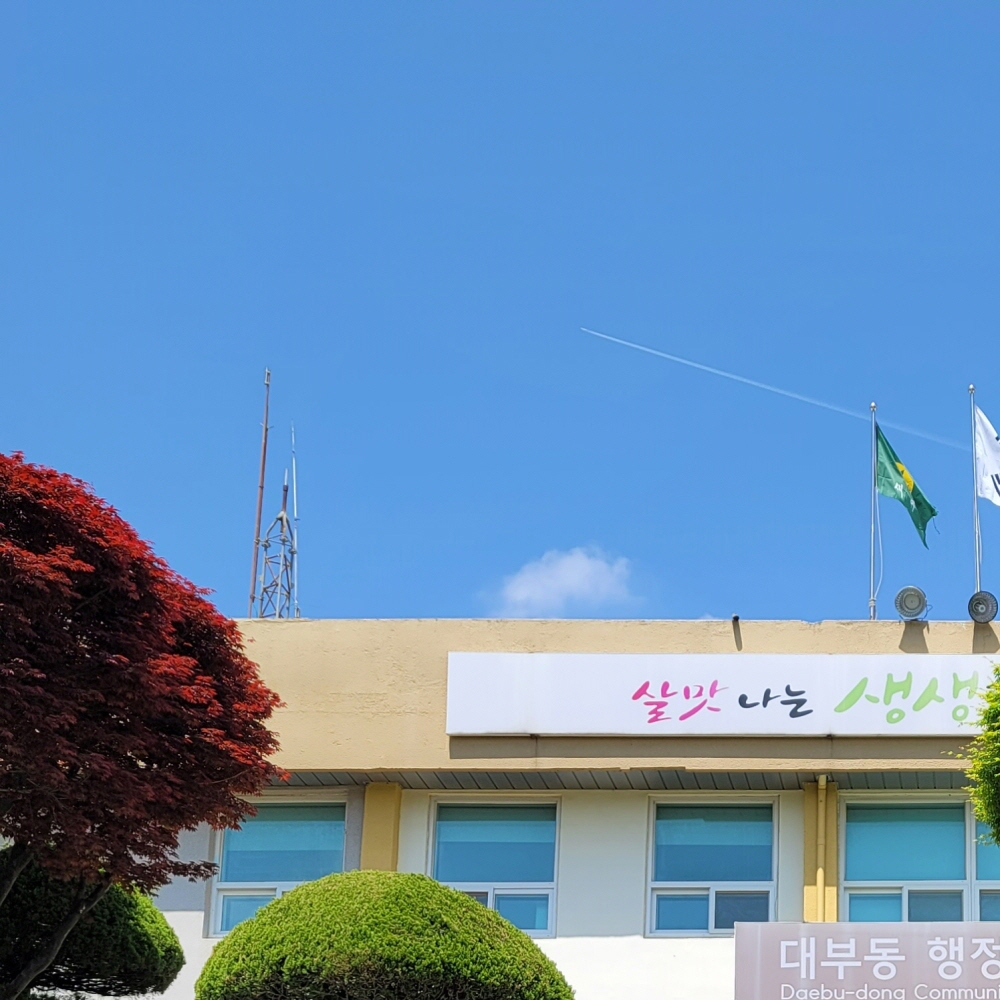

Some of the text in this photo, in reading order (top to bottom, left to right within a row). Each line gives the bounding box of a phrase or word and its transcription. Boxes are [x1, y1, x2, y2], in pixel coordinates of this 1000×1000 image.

[631, 670, 979, 724] 살맛 나는 생생
[780, 936, 906, 981] 대부동
